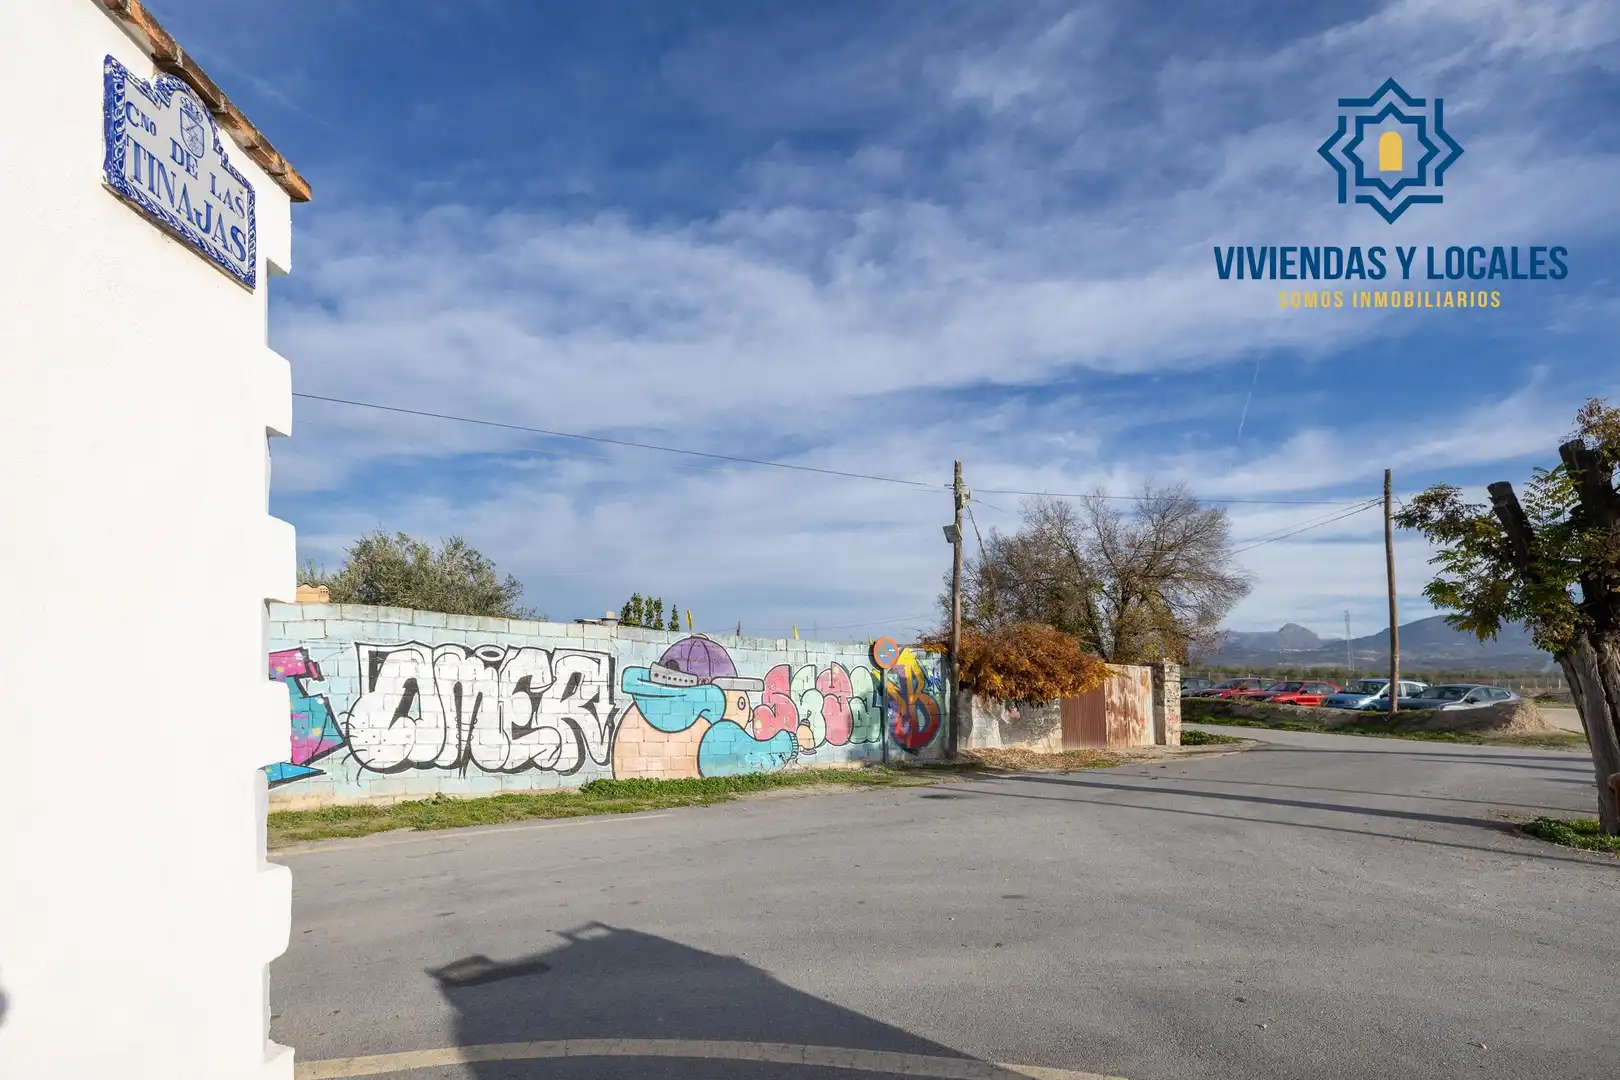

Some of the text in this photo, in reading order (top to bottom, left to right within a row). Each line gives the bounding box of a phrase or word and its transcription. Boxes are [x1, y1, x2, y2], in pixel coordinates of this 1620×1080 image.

[126, 133, 247, 263] TINAJAS
[169, 137, 198, 181] DE
[209, 171, 246, 220] LAS
